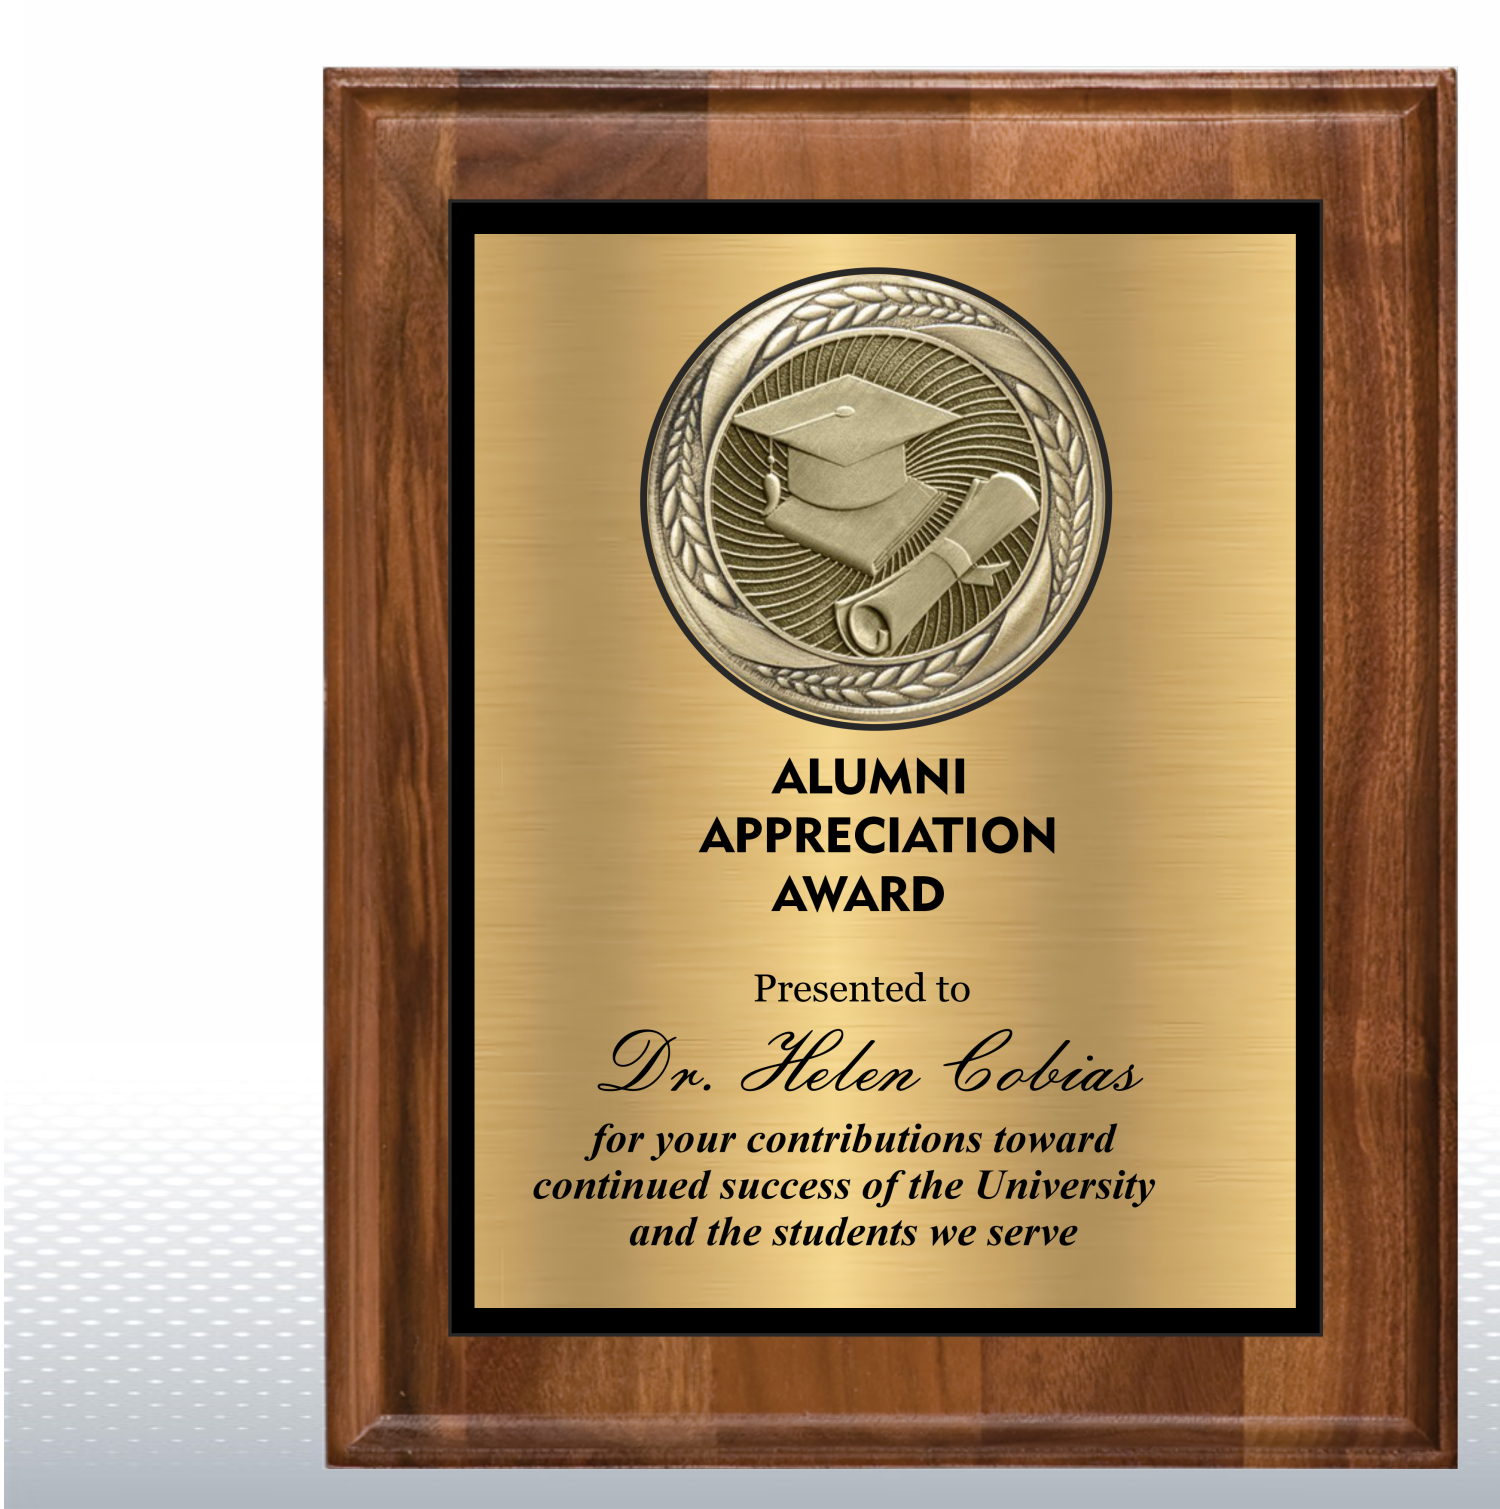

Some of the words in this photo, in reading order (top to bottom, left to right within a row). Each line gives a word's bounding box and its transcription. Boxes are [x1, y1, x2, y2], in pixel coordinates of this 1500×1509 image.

[771, 757, 965, 796] ALUMNI
[698, 816, 1055, 854] APPRECIATION
[771, 875, 945, 913] AWARD
[754, 971, 927, 1003] Presented
[935, 976, 970, 1003] to
[597, 1029, 711, 1092] Dr.
[740, 1028, 922, 1092] Helen
[943, 1028, 1144, 1092] Cobias
[583, 1123, 645, 1162] for
[650, 1132, 737, 1162] your
[747, 1123, 983, 1153] contributions
[993, 1123, 1118, 1153] toward
[533, 1169, 712, 1200] continued
[719, 1178, 849, 1200] success
[861, 1167, 904, 1208] of
[908, 1169, 964, 1200] the
[977, 1169, 1156, 1208] University
[629, 1216, 699, 1247] and
[706, 1216, 762, 1246] the
[772, 1216, 918, 1246] students
[931, 1225, 977, 1246] we
[986, 1225, 1078, 1247] serve
